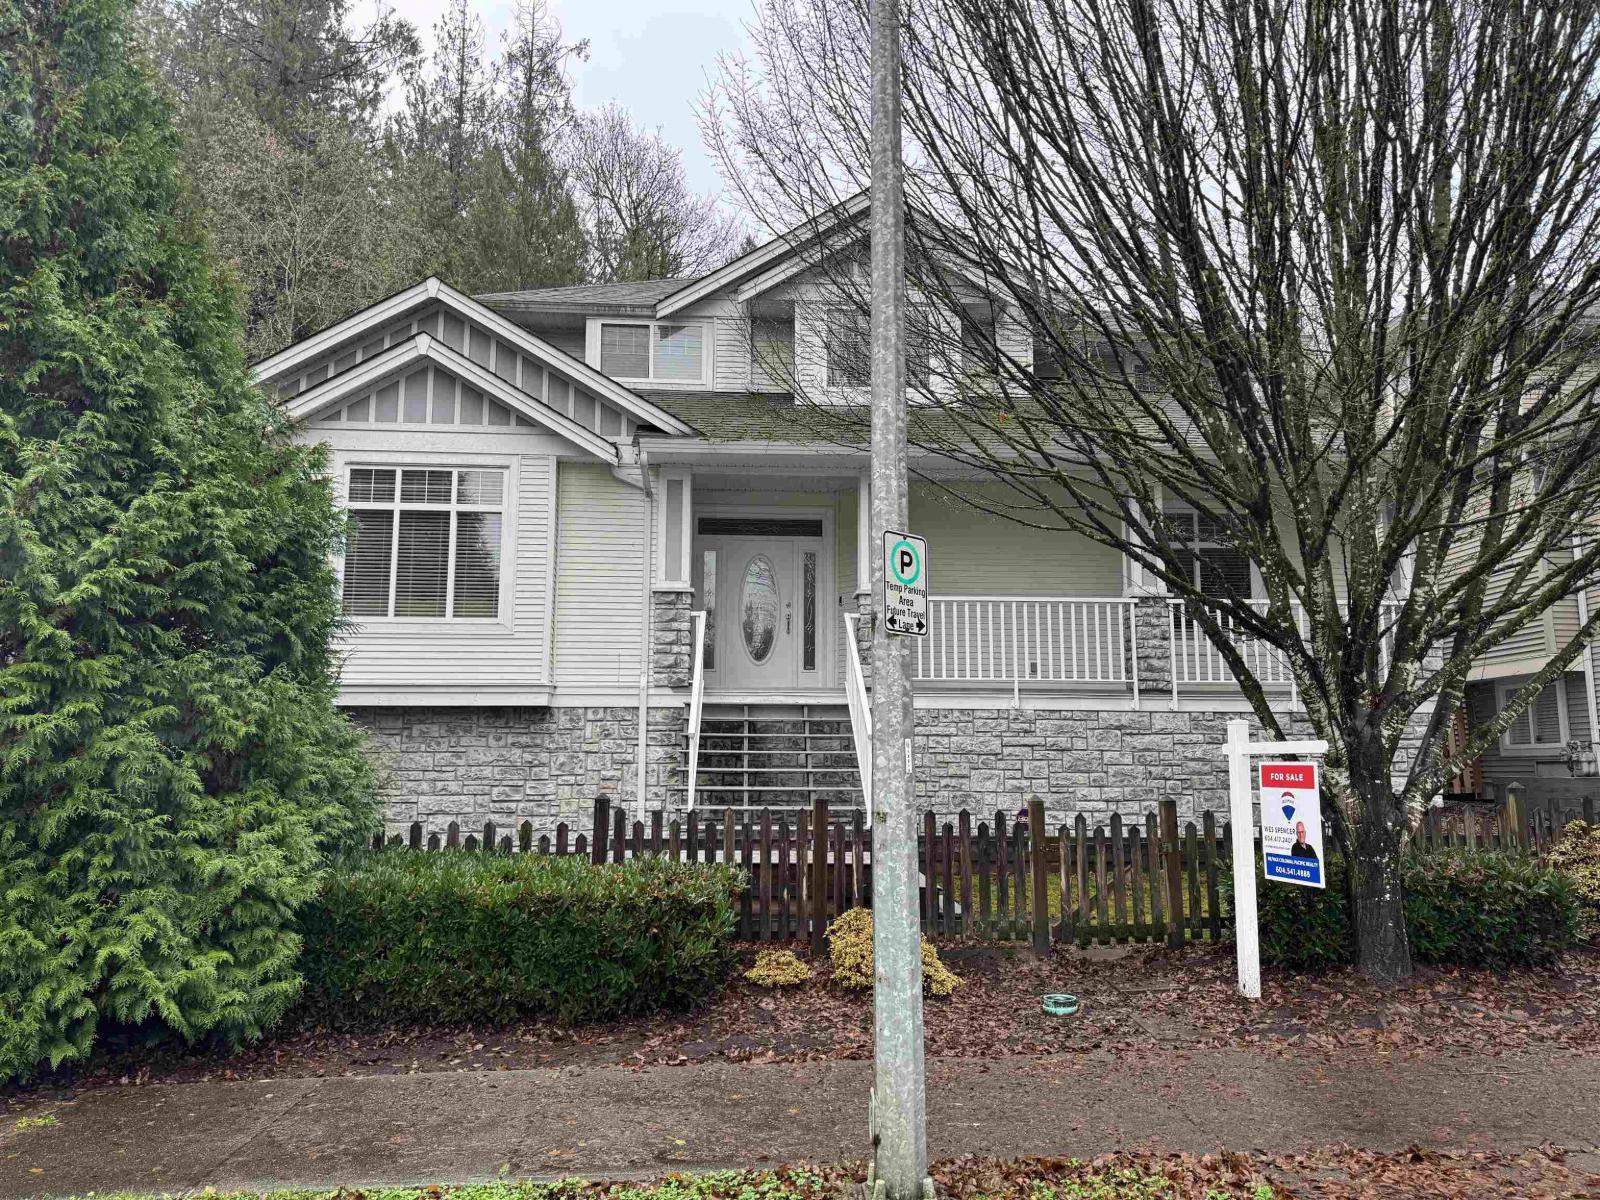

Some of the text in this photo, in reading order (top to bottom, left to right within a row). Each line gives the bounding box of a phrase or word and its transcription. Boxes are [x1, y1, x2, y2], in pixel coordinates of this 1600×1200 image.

[900, 550, 913, 574] P
[886, 581, 926, 598] Temp Parking
[899, 595, 914, 607] Area
[886, 605, 926, 620] Future Travel
[898, 619, 914, 630] Lane
[1270, 773, 1304, 782] FOR SALE
[1274, 826, 1296, 835] SPENCER
